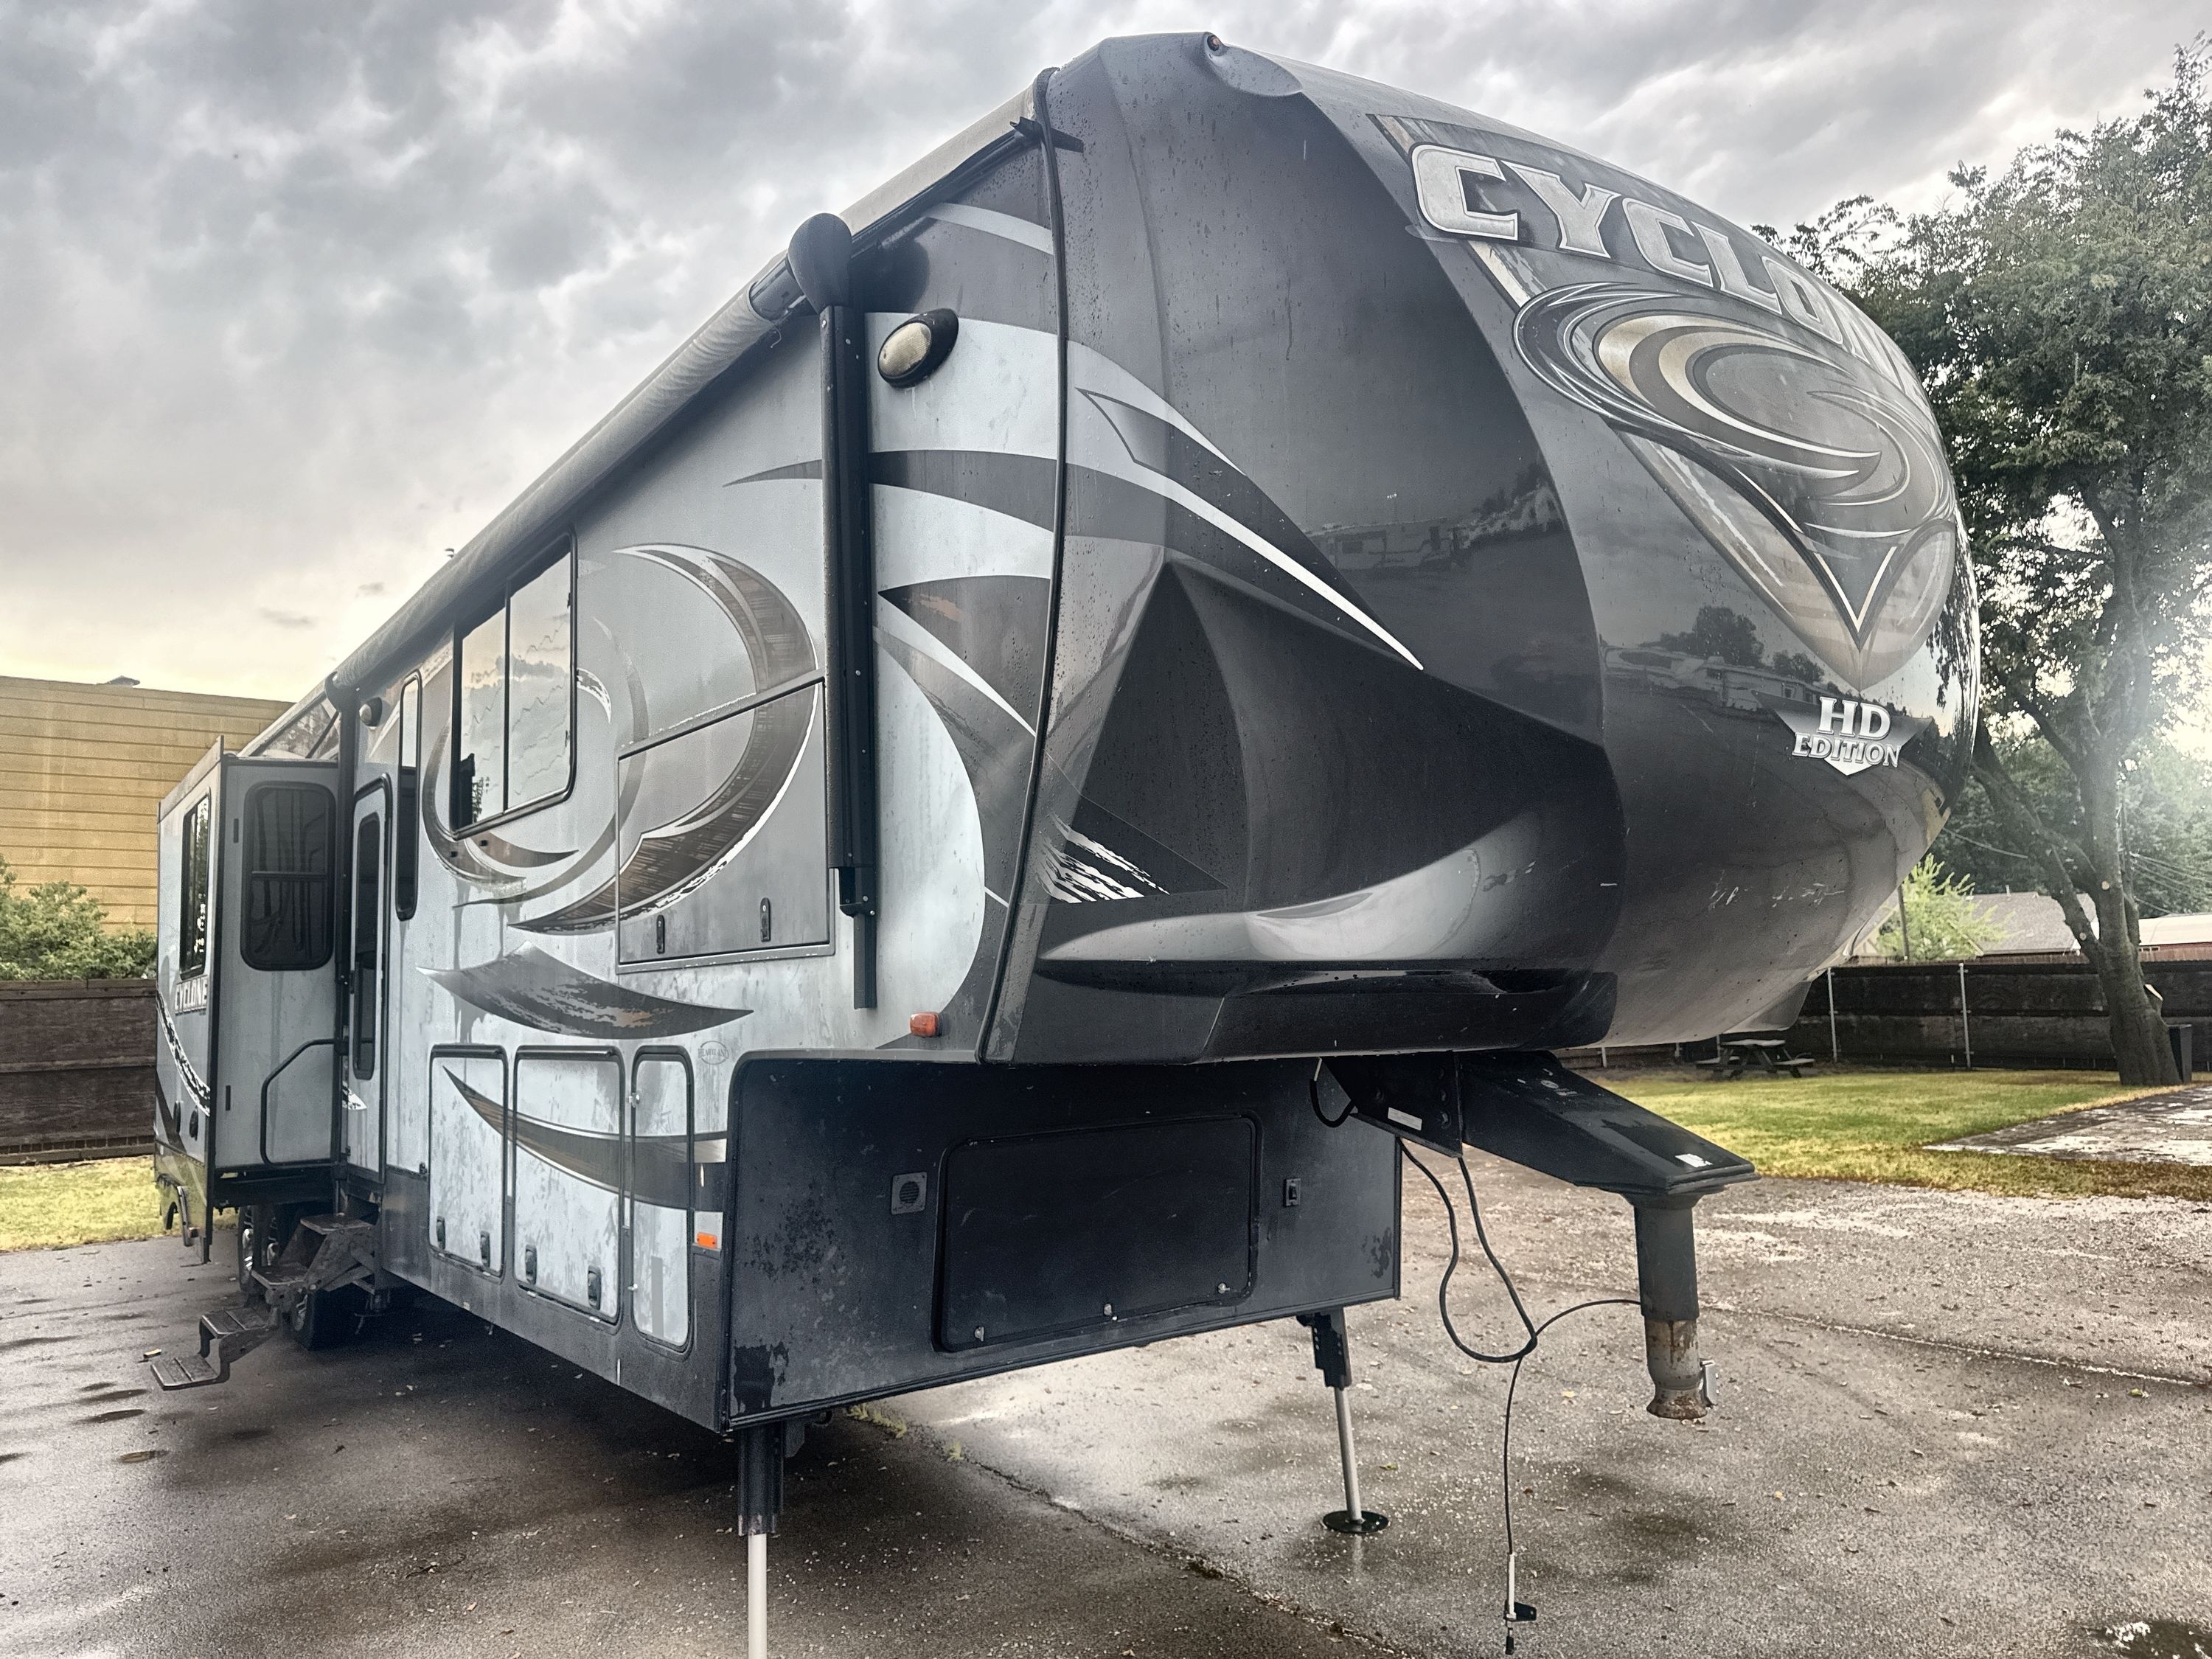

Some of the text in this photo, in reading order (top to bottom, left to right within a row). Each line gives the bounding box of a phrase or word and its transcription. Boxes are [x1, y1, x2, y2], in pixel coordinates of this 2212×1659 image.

[1816, 696, 1891, 740] HD
[1791, 731, 1902, 768] EDITION
[175, 975, 208, 1014] CYCLONE
